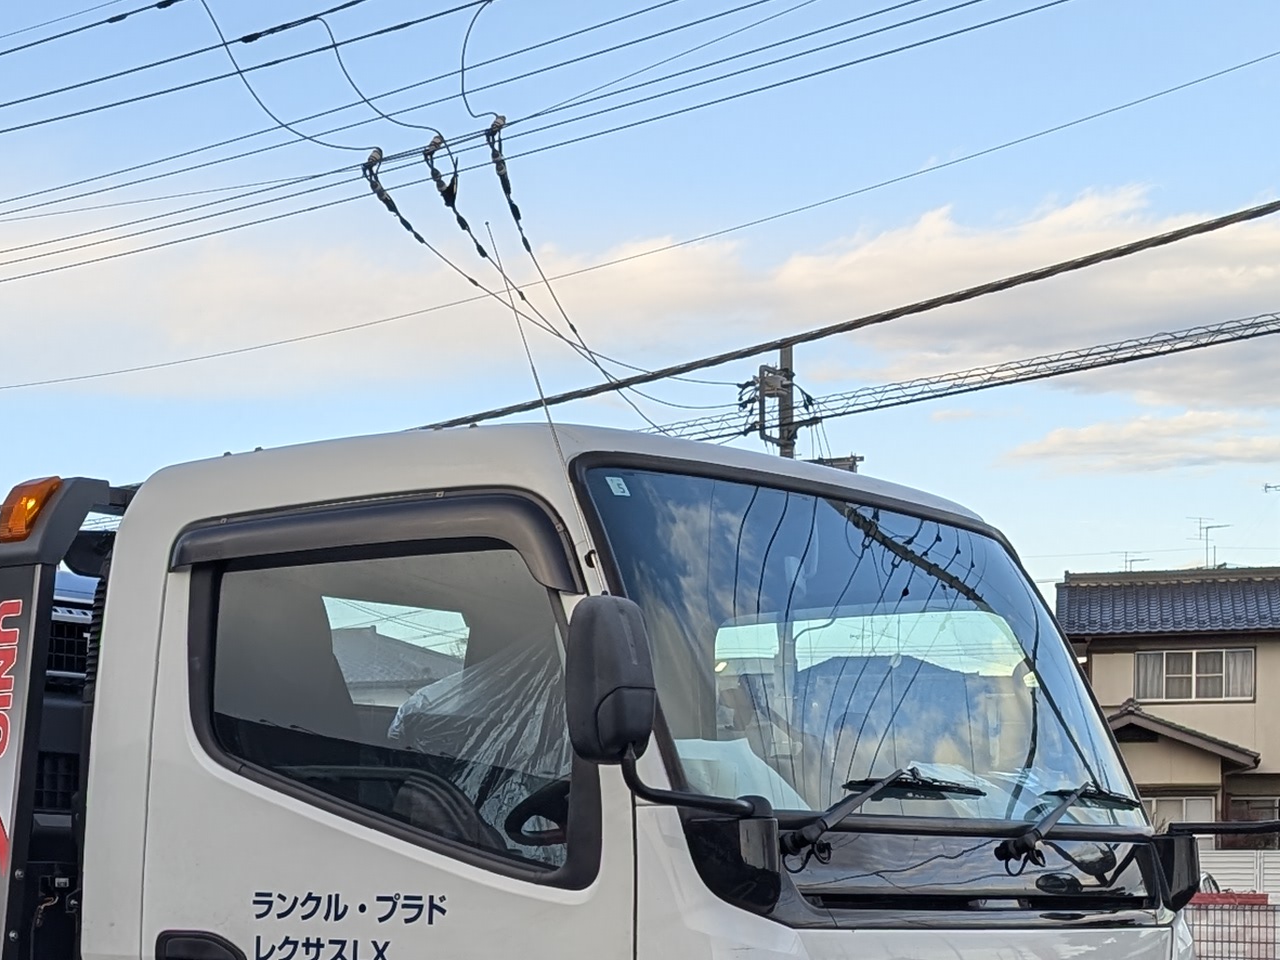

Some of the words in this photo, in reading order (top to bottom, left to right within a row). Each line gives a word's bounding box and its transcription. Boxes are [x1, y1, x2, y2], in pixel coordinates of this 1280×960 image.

[616, 483, 626, 494] 5
[252, 891, 448, 925] ランクル・プラド
